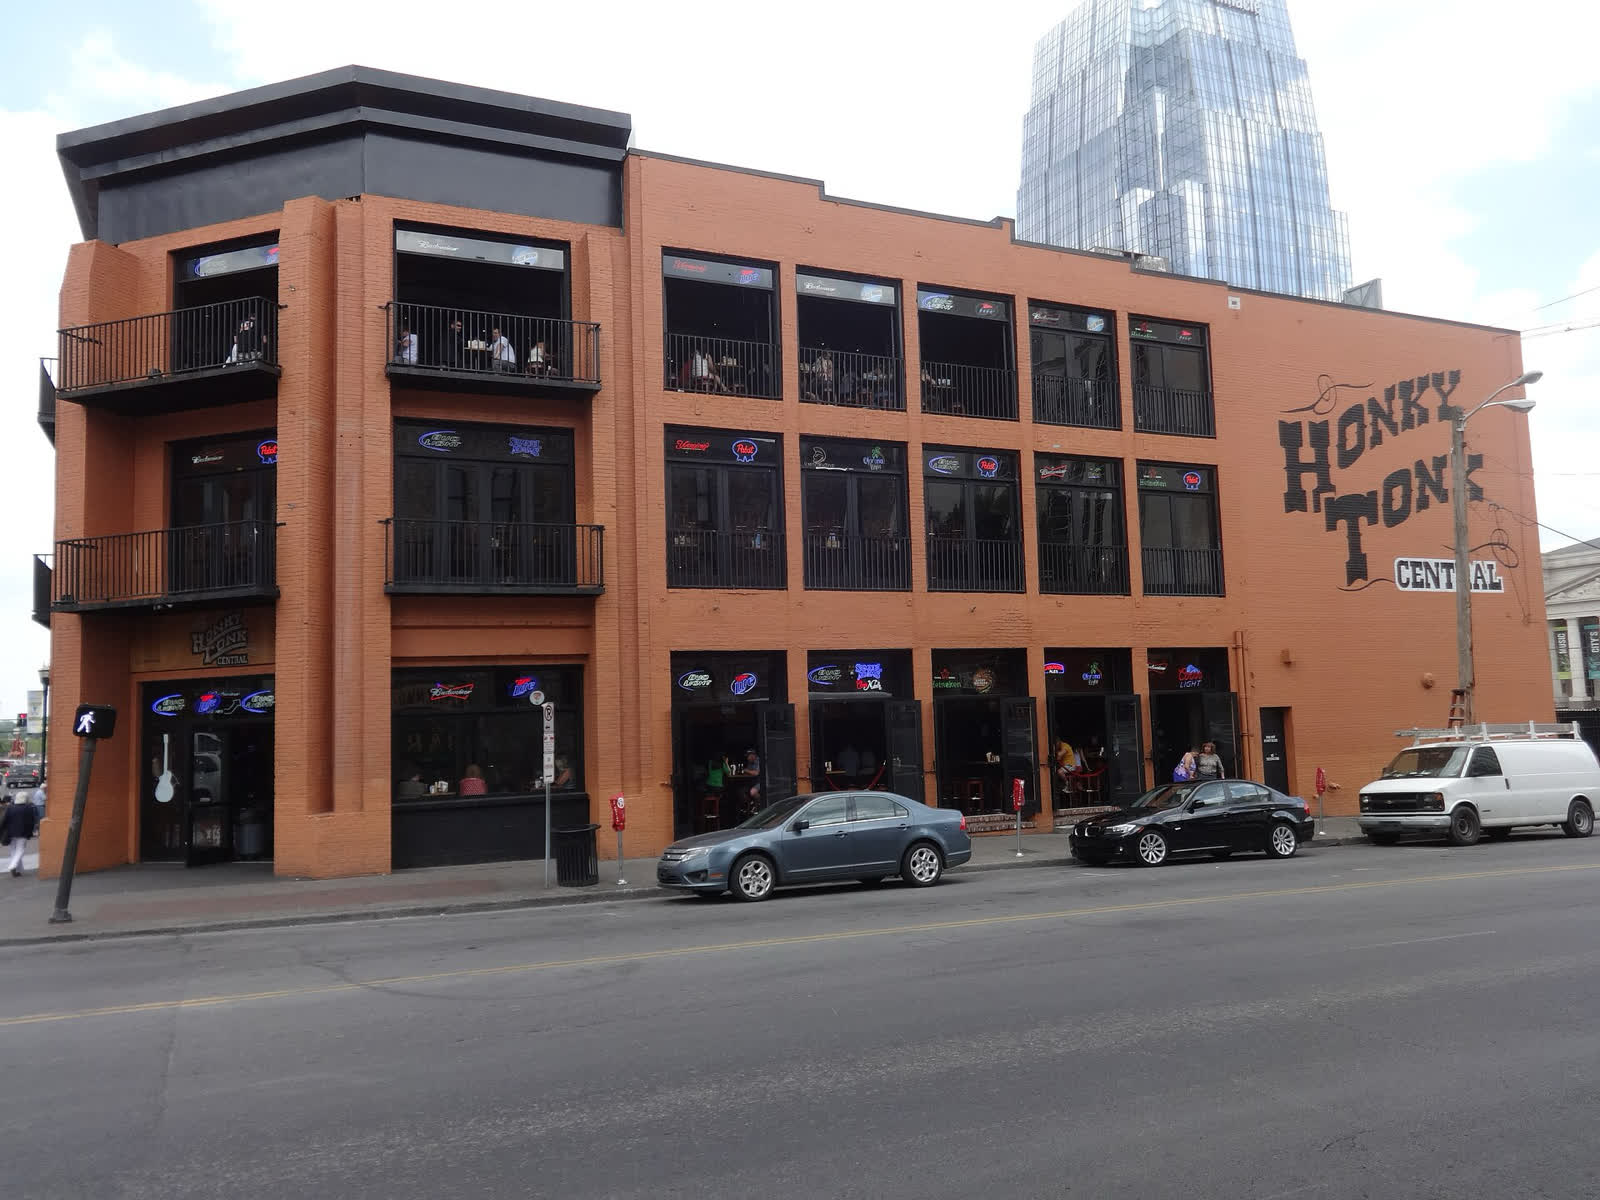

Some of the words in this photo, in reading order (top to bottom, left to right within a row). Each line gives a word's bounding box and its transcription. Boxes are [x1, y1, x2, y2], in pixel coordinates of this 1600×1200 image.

[1278, 369, 1461, 513] HONKY
[1324, 453, 1484, 587] TONK
[1396, 560, 1503, 591] CENTAL
[1557, 633, 1567, 654] MUSIC
[1590, 631, 1600, 653] CITY'S
